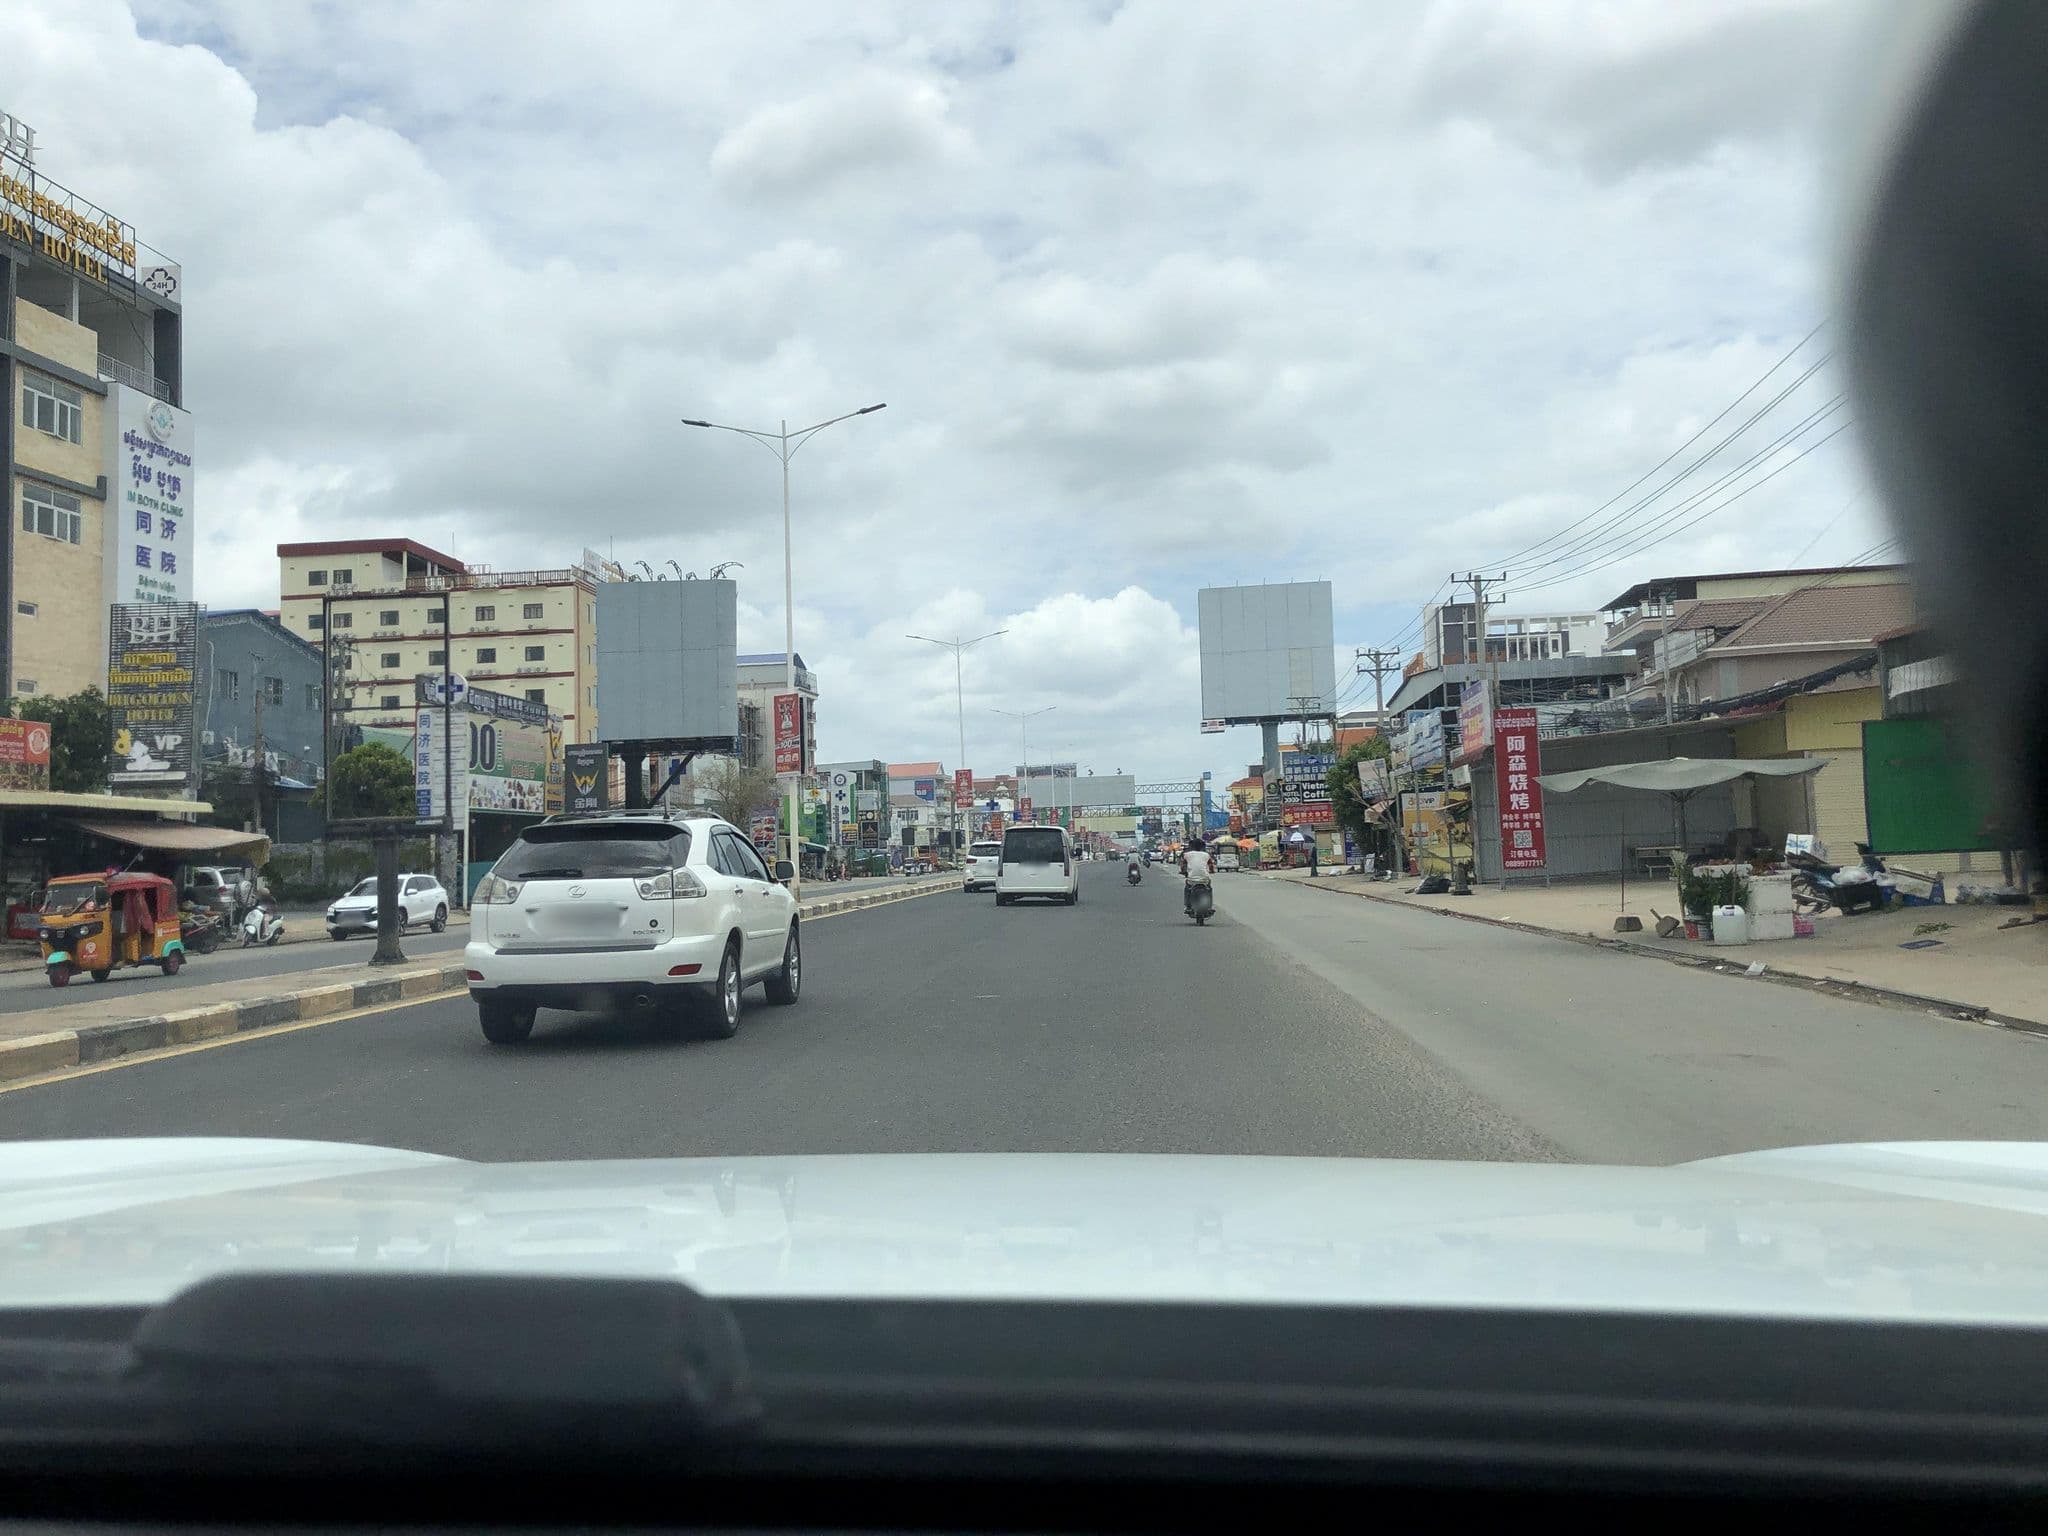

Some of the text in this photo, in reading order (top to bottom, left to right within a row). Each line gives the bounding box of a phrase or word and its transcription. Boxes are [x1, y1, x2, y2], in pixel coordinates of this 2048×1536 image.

[43, 233, 108, 285] HOTEL
[137, 492, 159, 510] BOTH
[160, 501, 184, 518] CLINIC
[417, 714, 431, 785] 同济医院
